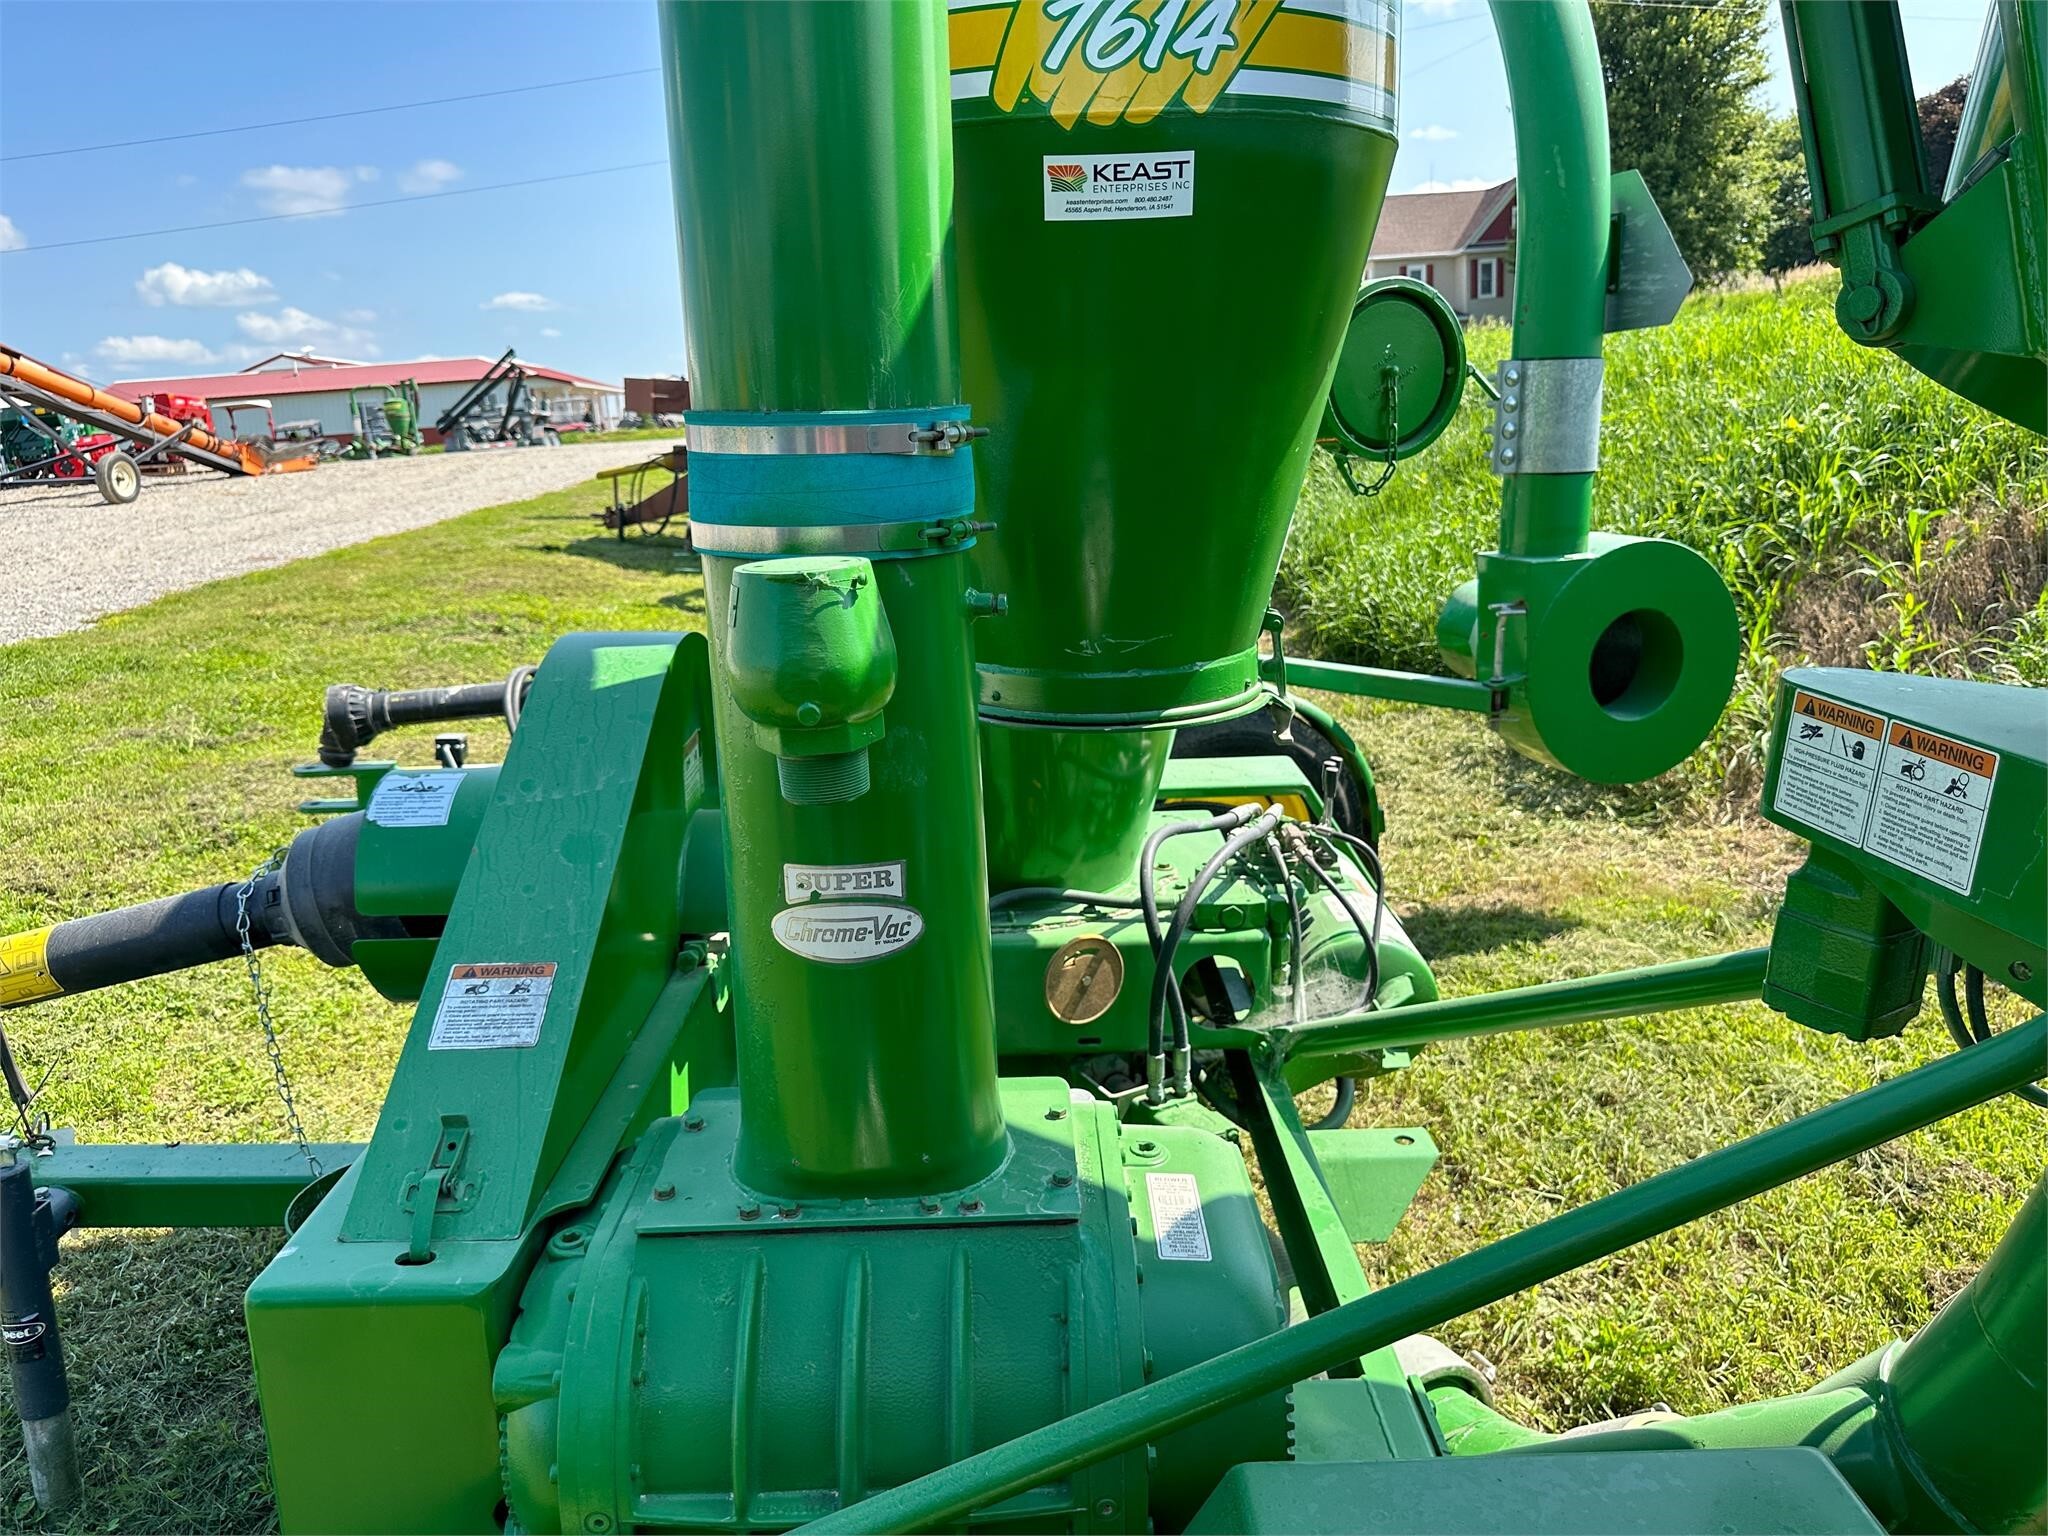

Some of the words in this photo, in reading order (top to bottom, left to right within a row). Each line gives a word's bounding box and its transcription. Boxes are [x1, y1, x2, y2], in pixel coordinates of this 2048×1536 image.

[1044, 0, 1237, 73] 7614
[1093, 160, 1190, 182] KEAST
[1093, 182, 1168, 193] ENTERPRISES
[1172, 181, 1190, 190] INC
[1818, 703, 1874, 734] WARNING
[1917, 736, 1984, 771] WARNING
[1830, 760, 1845, 770] FLUID
[1845, 765, 1865, 778] HAZARD
[1896, 784, 1922, 799] ROTATING
[1924, 795, 1939, 804] PART
[1940, 801, 1964, 814] HAZARD
[795, 869, 894, 891] SUPER
[785, 914, 913, 943] Chrome-Vac
[480, 966, 545, 976] WARNING
